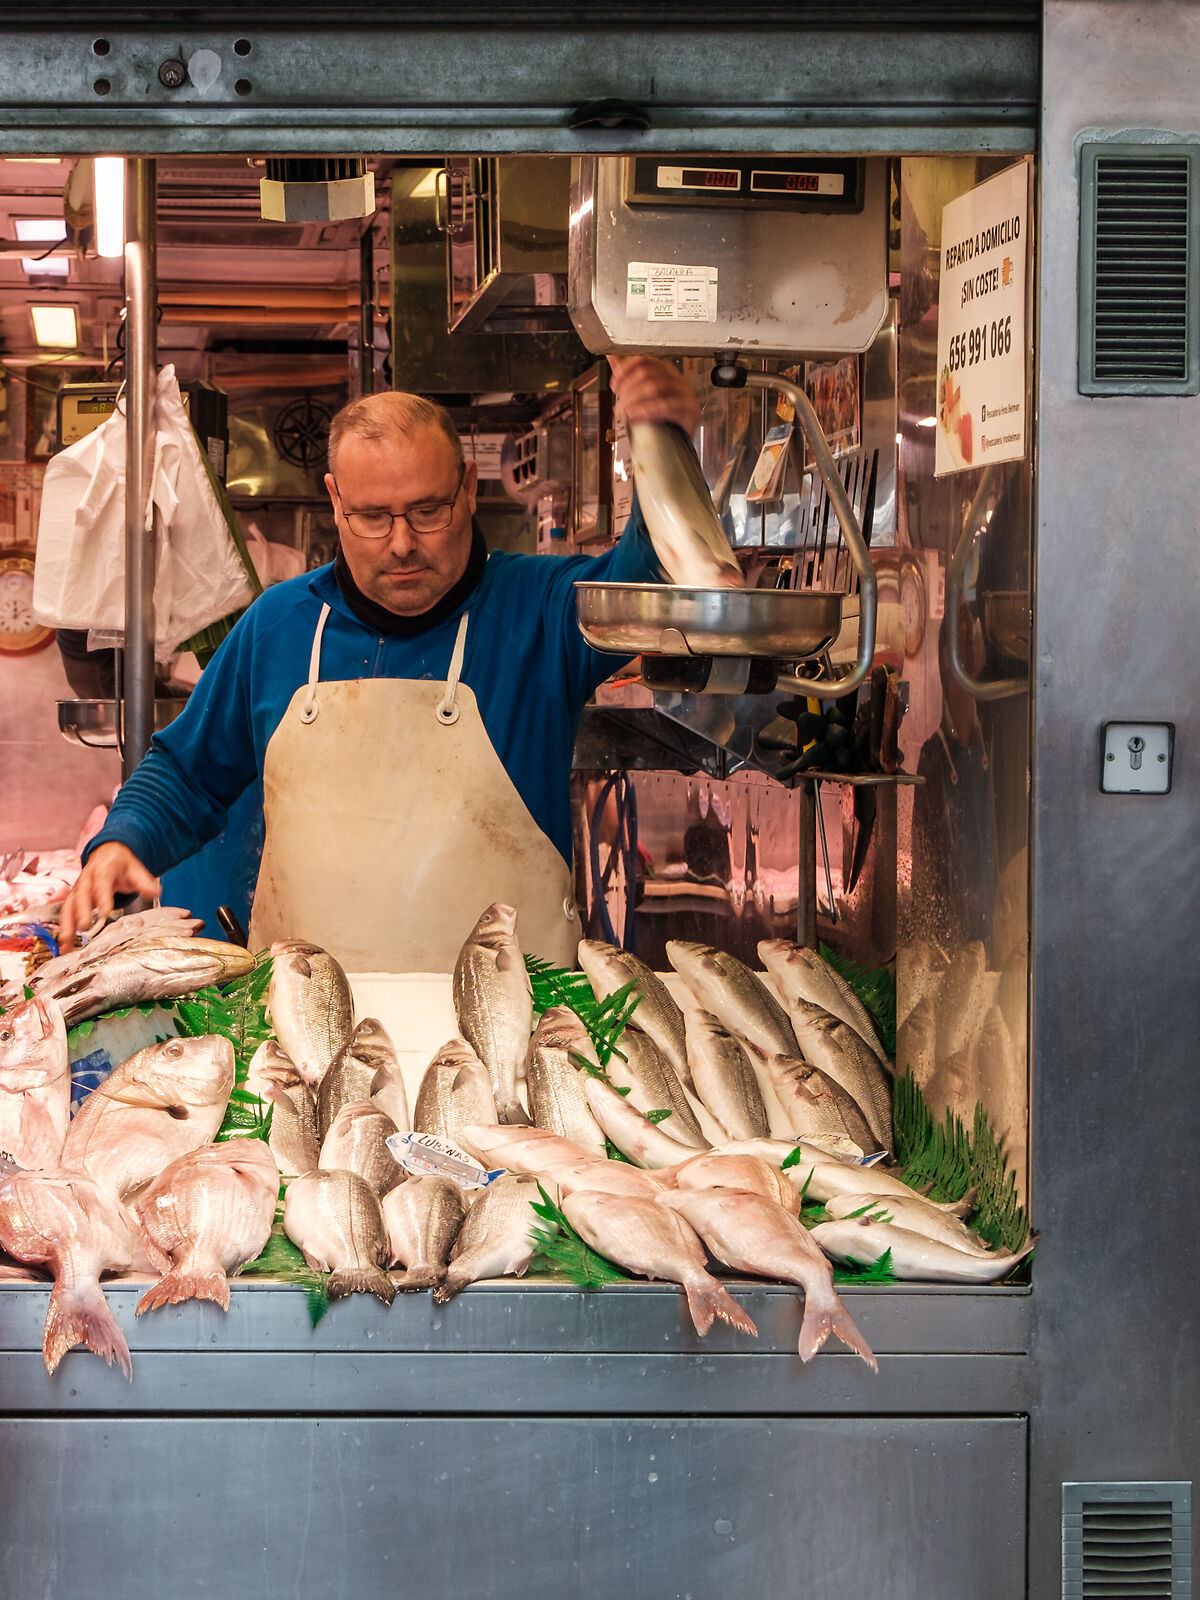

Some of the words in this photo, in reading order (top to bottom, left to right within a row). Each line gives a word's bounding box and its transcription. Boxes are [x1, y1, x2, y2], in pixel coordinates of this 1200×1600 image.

[945, 237, 973, 271] REPARTO
[974, 234, 980, 258] A
[981, 215, 1021, 254] DOMICILIO
[960, 279, 974, 309] ¡SIN
[975, 267, 999, 298] COSTE!
[949, 331, 967, 372] 656
[968, 324, 987, 366] 991
[990, 315, 1011, 359] 066
